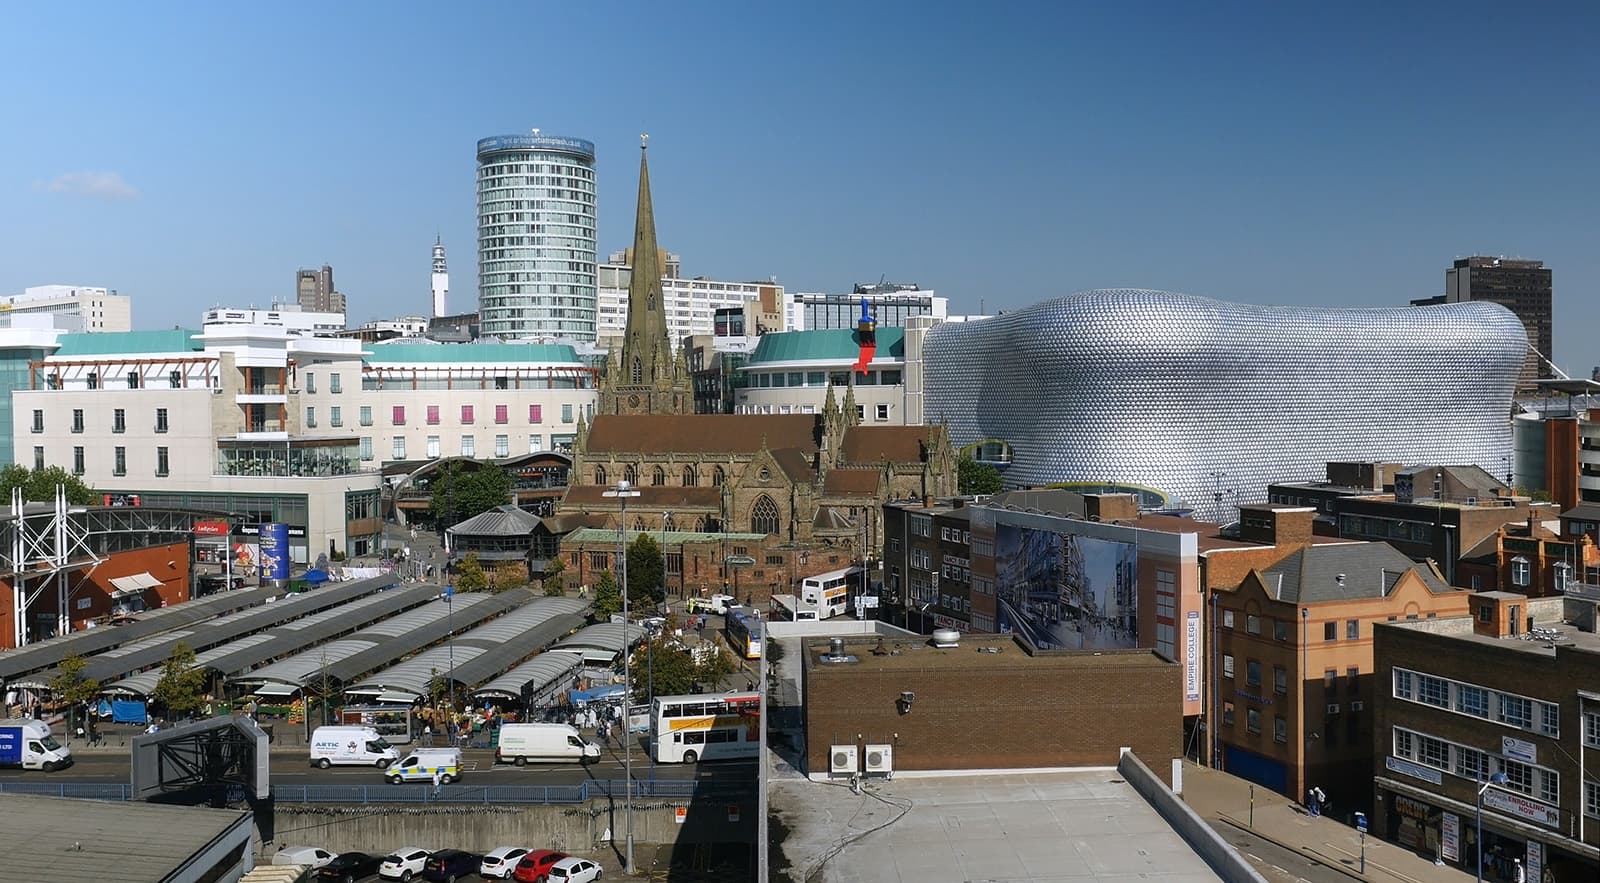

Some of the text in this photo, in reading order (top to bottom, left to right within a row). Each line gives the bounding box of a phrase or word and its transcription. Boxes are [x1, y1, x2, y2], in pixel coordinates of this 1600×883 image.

[1395, 795, 1430, 819] CREDIT
[1508, 796, 1545, 812] ENROLLING
[1519, 806, 1535, 815] NOW
